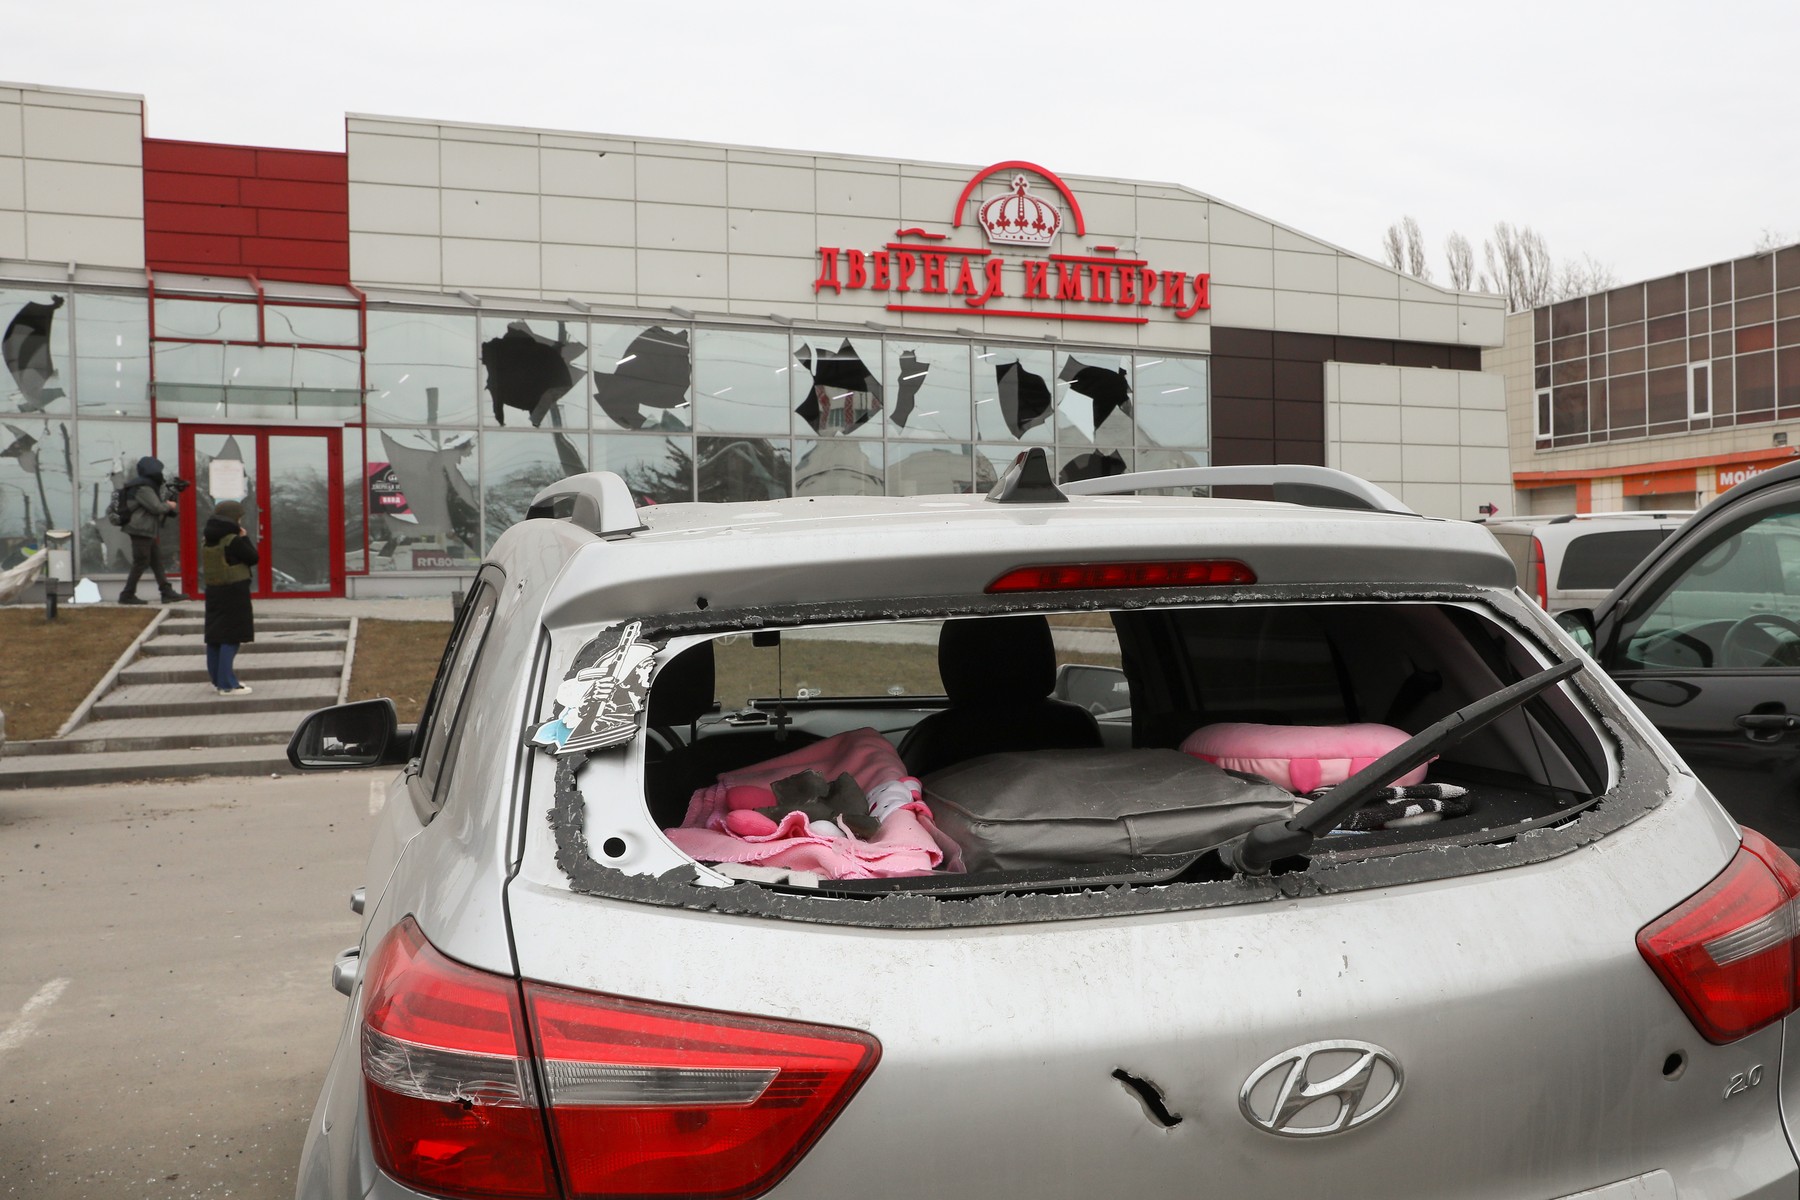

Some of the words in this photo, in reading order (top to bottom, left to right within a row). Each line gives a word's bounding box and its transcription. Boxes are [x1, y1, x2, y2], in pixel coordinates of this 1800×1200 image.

[814, 246, 1004, 307] ДВЕРНАЯ
[1023, 260, 1211, 319] ИМПЕРИЯ
[1720, 466, 1768, 485] МОЙ
[1723, 1064, 1764, 1100] 2.0
